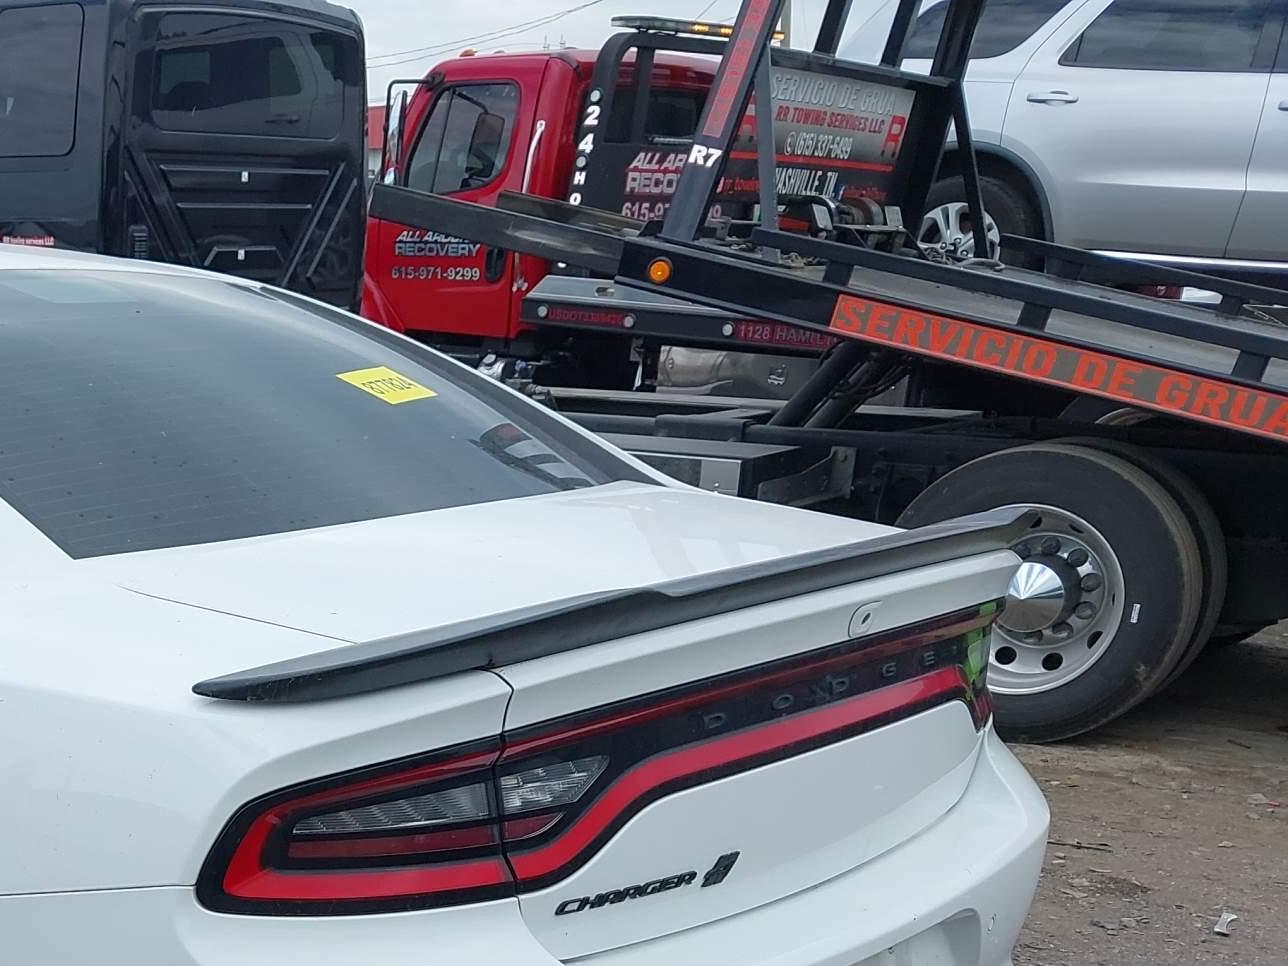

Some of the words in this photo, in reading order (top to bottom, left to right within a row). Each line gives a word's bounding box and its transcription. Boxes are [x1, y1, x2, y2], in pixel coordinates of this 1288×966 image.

[772, 73, 837, 107] SERVICIO
[839, 85, 861, 110] DE
[792, 107, 827, 127] TOWING
[827, 111, 869, 132] SERVICES
[868, 117, 885, 134] LLC
[629, 152, 662, 171] ALL
[688, 144, 723, 167] R7
[396, 231, 421, 242] ALL
[395, 243, 481, 257] RECOVERY
[392, 266, 480, 280] 615-971-9299
[739, 324, 771, 340] 1128
[834, 300, 1058, 378] SERVICIO
[1070, 350, 1145, 400] DE
[703, 650, 936, 730] DODGE
[554, 870, 698, 917] CHARGER
